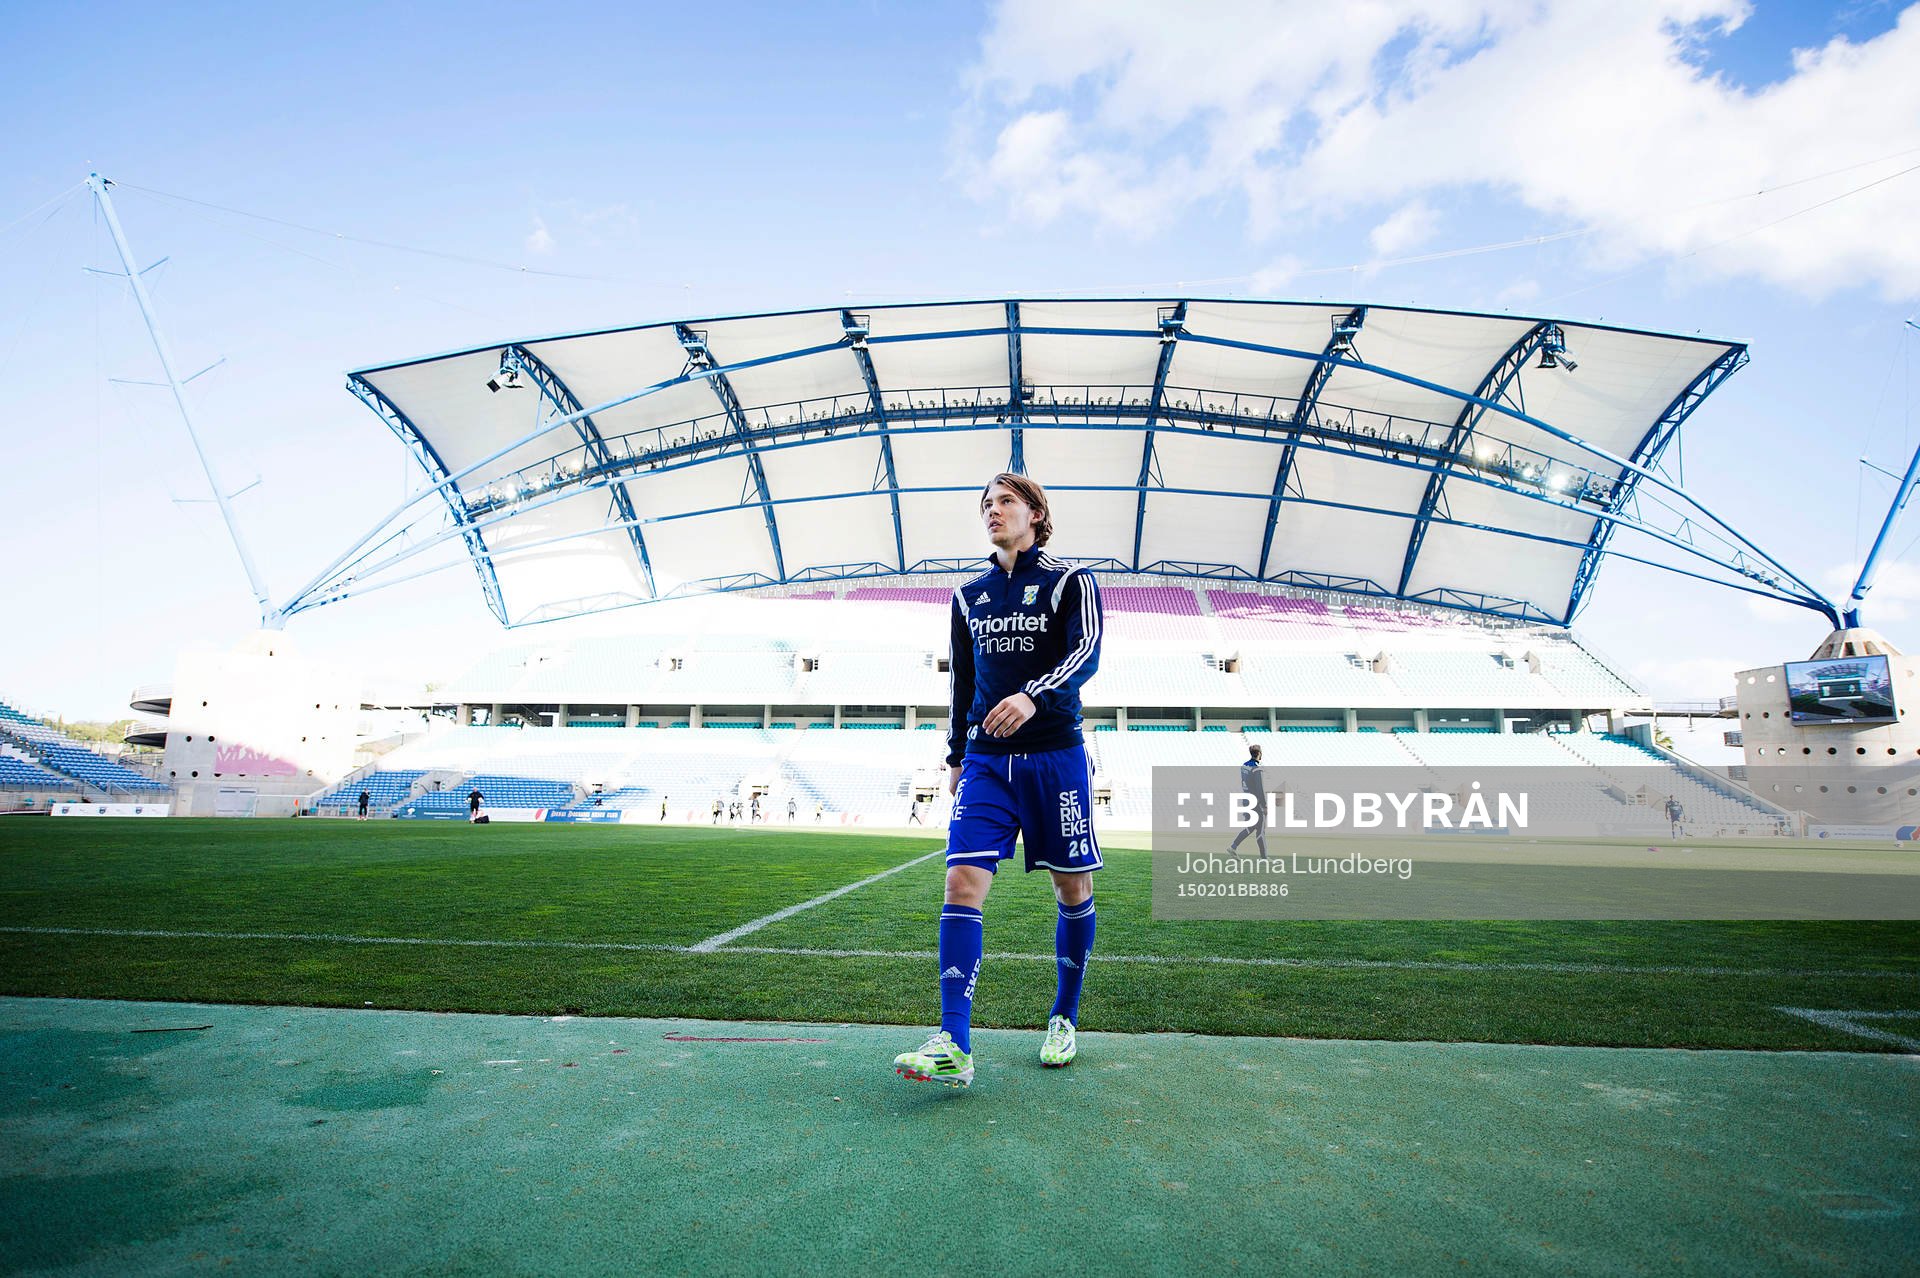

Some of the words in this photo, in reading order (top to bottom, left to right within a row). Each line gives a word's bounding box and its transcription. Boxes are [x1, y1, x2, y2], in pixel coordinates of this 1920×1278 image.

[970, 612, 1048, 638] Prioritet
[978, 634, 1035, 655] Finans
[1059, 789, 1079, 808] SE
[1060, 804, 1082, 822] RN
[1061, 818, 1088, 838] EKE
[1068, 837, 1090, 859] 26
